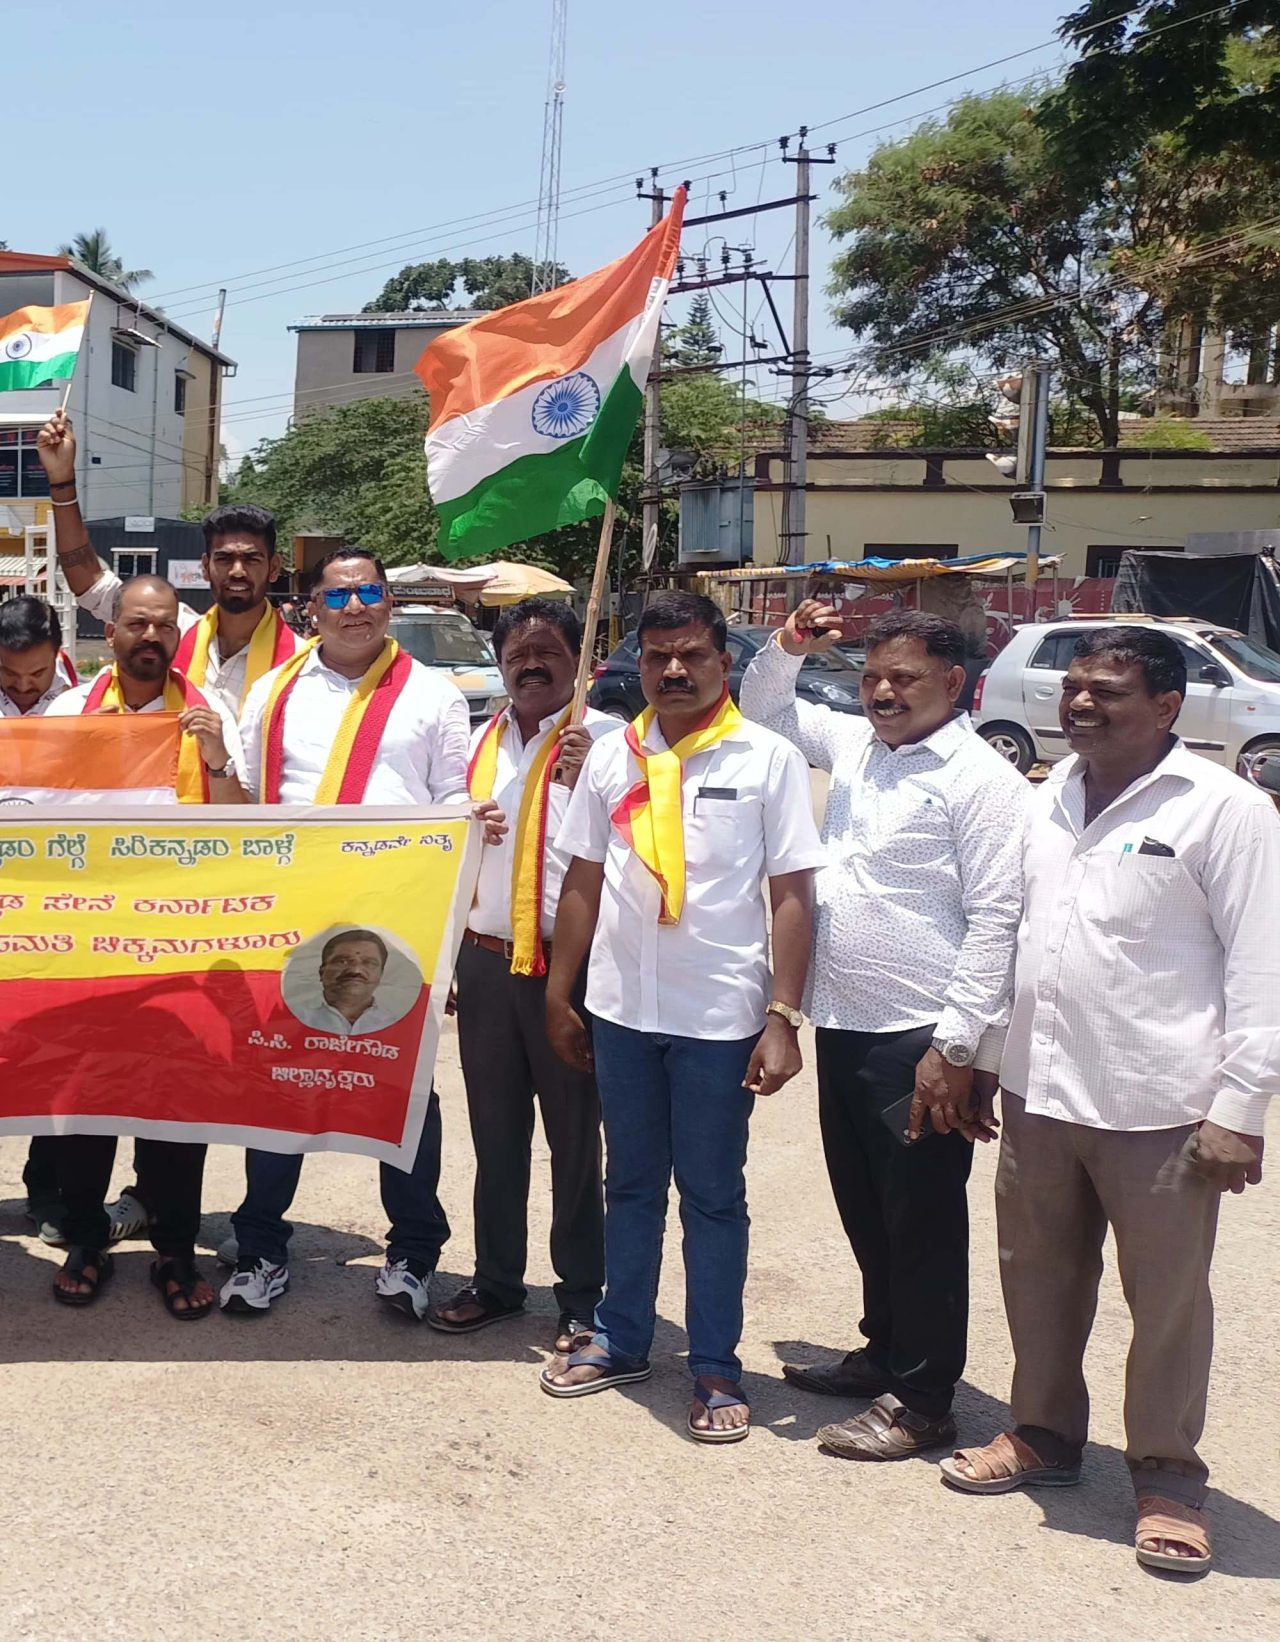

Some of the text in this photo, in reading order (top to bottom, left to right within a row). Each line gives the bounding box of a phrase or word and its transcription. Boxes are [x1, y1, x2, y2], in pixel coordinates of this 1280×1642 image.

[47, 833, 86, 869] ಗೆಲ್ಗೆ
[111, 835, 230, 866] ಸಿರಿಕನ್ನಡಂ
[242, 833, 295, 866] ಬಾಳ್ಗೆ
[341, 834, 453, 857] ಕನ್ನಡವೇ ನಿತ್ಯ
[43, 893, 116, 912] ಸೇನೆ
[133, 895, 276, 915] ಕರ್ನಾಟಕ
[93, 930, 301, 963] ಚಿಕ್ಕಮಗಳೂರು
[248, 1030, 400, 1060] ಪಿ.ಸಿ. ರಾಜೇಗೌಡ
[271, 1066, 375, 1091] ಜಿಲ್ಲಾಧ್ಯಕ್ಷರು
